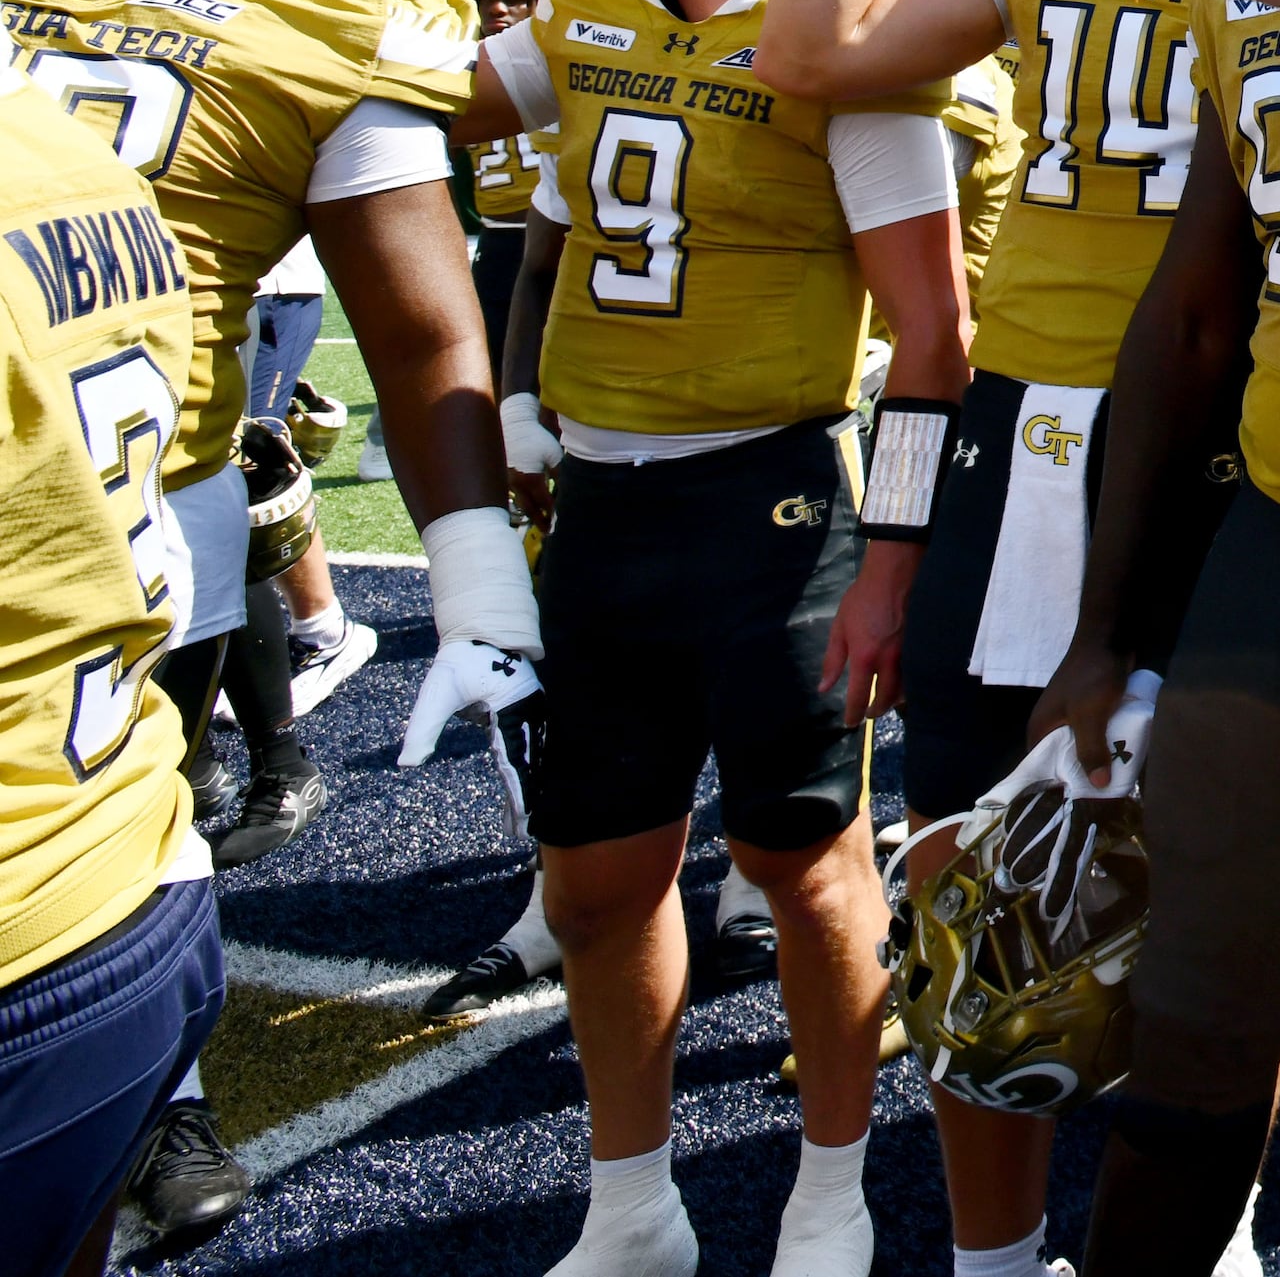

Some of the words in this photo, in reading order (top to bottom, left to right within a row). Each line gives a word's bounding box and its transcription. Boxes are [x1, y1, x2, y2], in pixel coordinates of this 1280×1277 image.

[86, 18, 218, 69] TECH
[568, 61, 678, 105] GEORGIA
[684, 79, 776, 124] TECH
[1020, 0, 1198, 215] 14
[587, 106, 695, 319] 9
[1022, 413, 1083, 467] GT
[772, 495, 828, 527] GT
